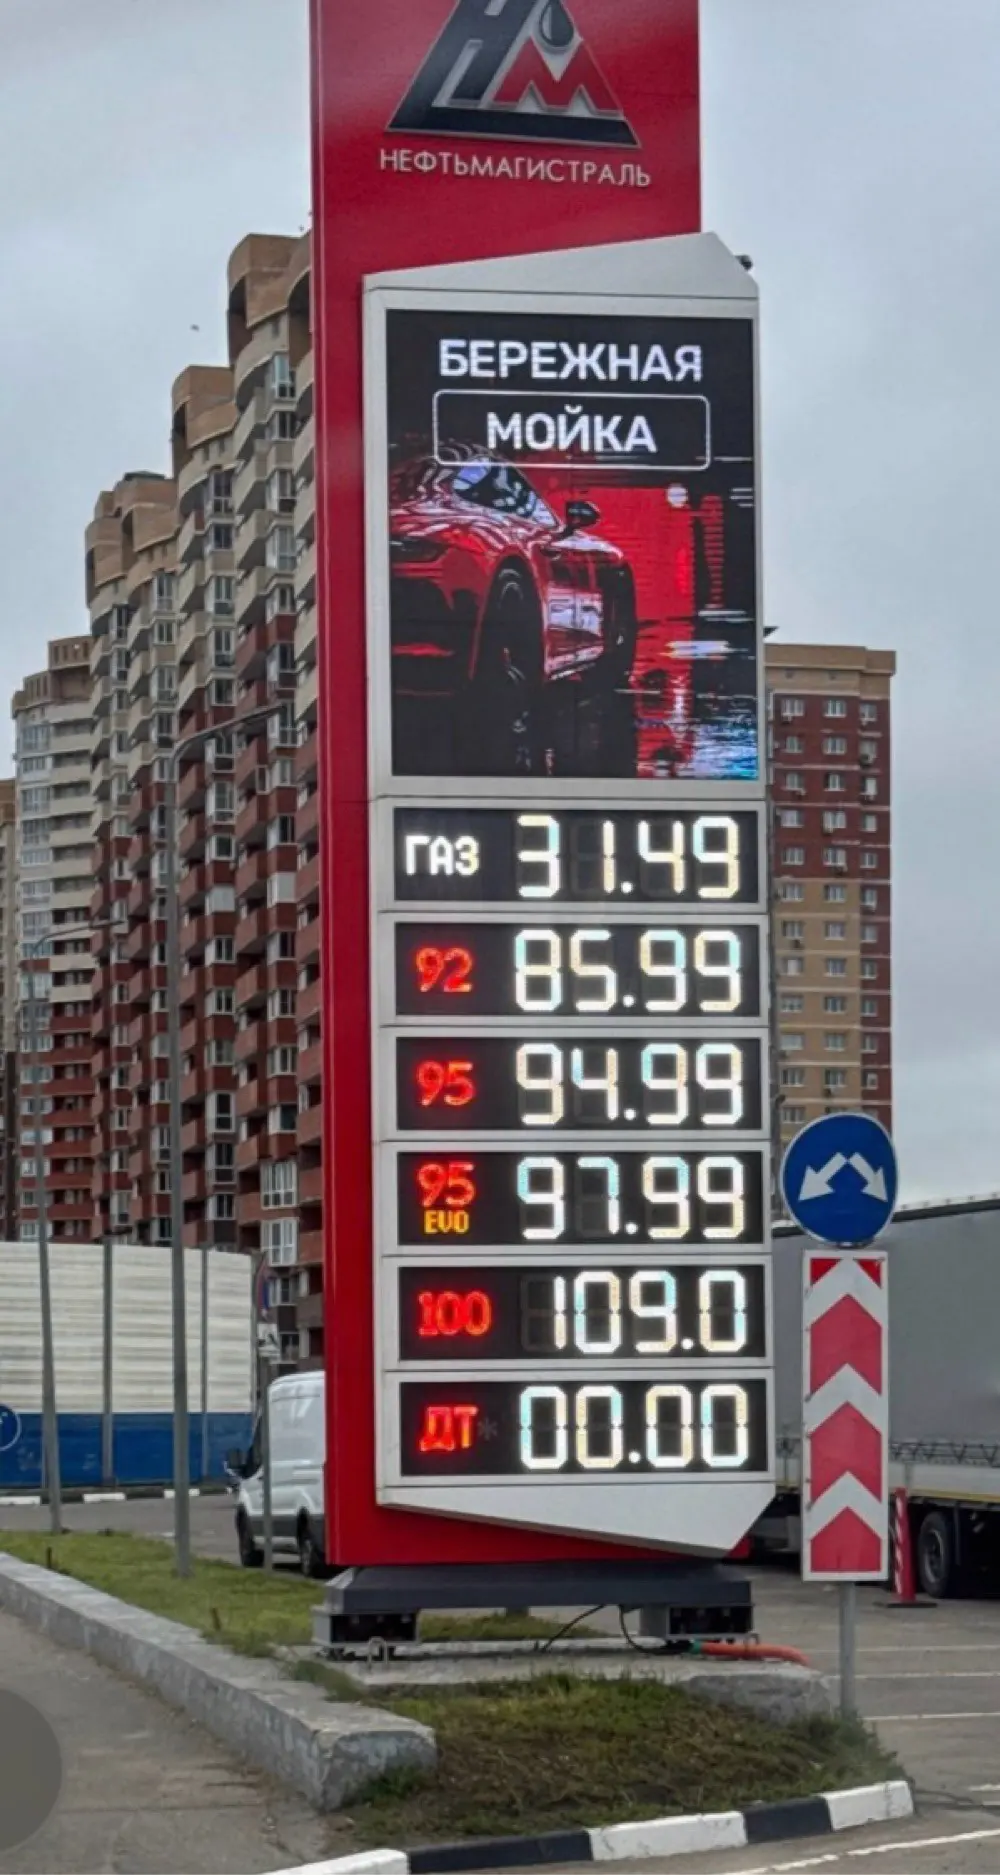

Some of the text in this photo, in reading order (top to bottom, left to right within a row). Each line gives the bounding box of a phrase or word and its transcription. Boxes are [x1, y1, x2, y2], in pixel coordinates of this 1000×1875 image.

[380, 148, 651, 188] НЕФТЬМАГИСТРАЛЬ
[439, 338, 702, 383] БЕРЕЖНАЯ
[486, 404, 657, 454] МОЙКА
[404, 814, 740, 899] ГАЗ 31.49
[415, 929, 742, 1012] 92 85.99
[416, 1042, 744, 1126] 95 94.99
[416, 1156, 745, 1240] 95 97.99
[423, 1209, 470, 1235] EVO
[418, 1269, 747, 1354] 100 109.0
[519, 1384, 749, 1470] 00.00
